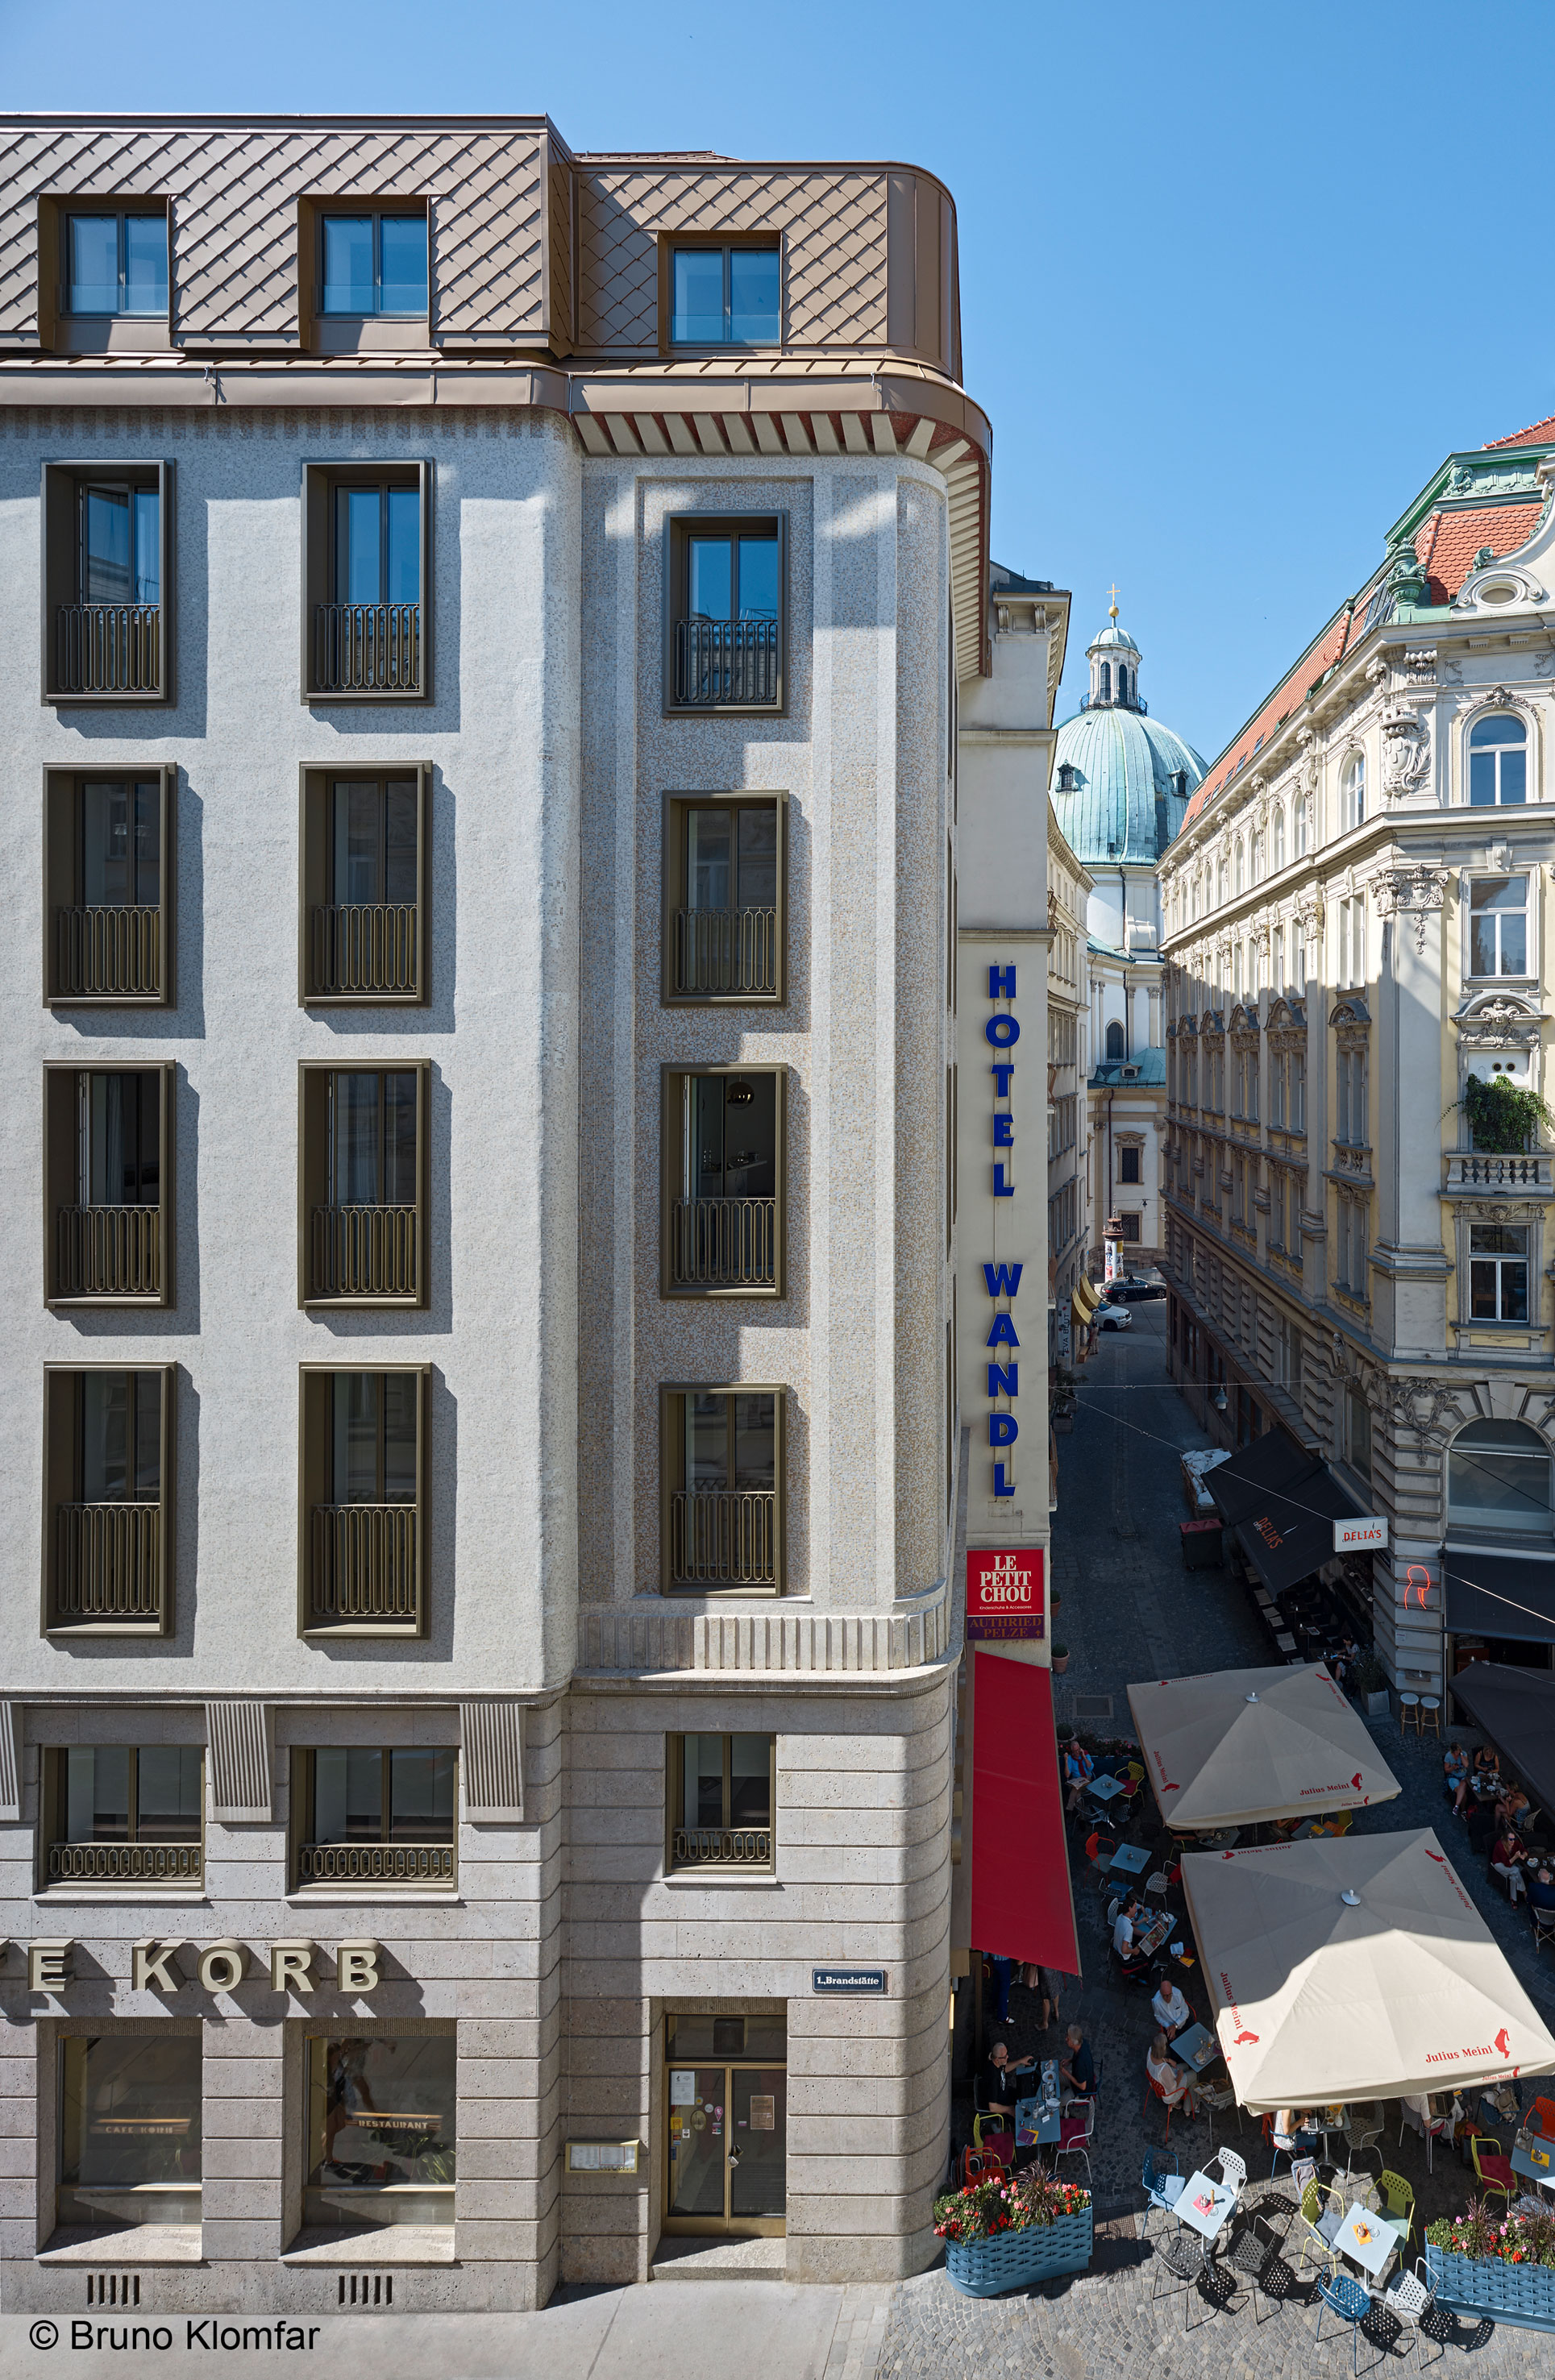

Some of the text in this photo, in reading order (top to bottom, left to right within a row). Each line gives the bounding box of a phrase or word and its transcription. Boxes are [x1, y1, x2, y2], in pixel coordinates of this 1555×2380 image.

[983, 965, 1024, 1497] HOTEL WANDL
[1344, 1529, 1382, 1541] DELIA'S
[994, 1556, 1017, 1571] LE
[979, 1571, 1032, 1587] PETIT
[980, 1586, 1032, 1602] CHOU
[970, 1617, 1042, 1627] AUTHRIED
[983, 1628, 1029, 1638] PELZE
[1299, 1783, 1350, 1796] Julius Meinl
[131, 1938, 384, 1992] KORB
[1220, 1972, 1243, 2029] Julius Meinl
[1425, 2045, 1494, 2063] Julius Meinl
[358, 2120, 428, 2129] RESTAURANT
